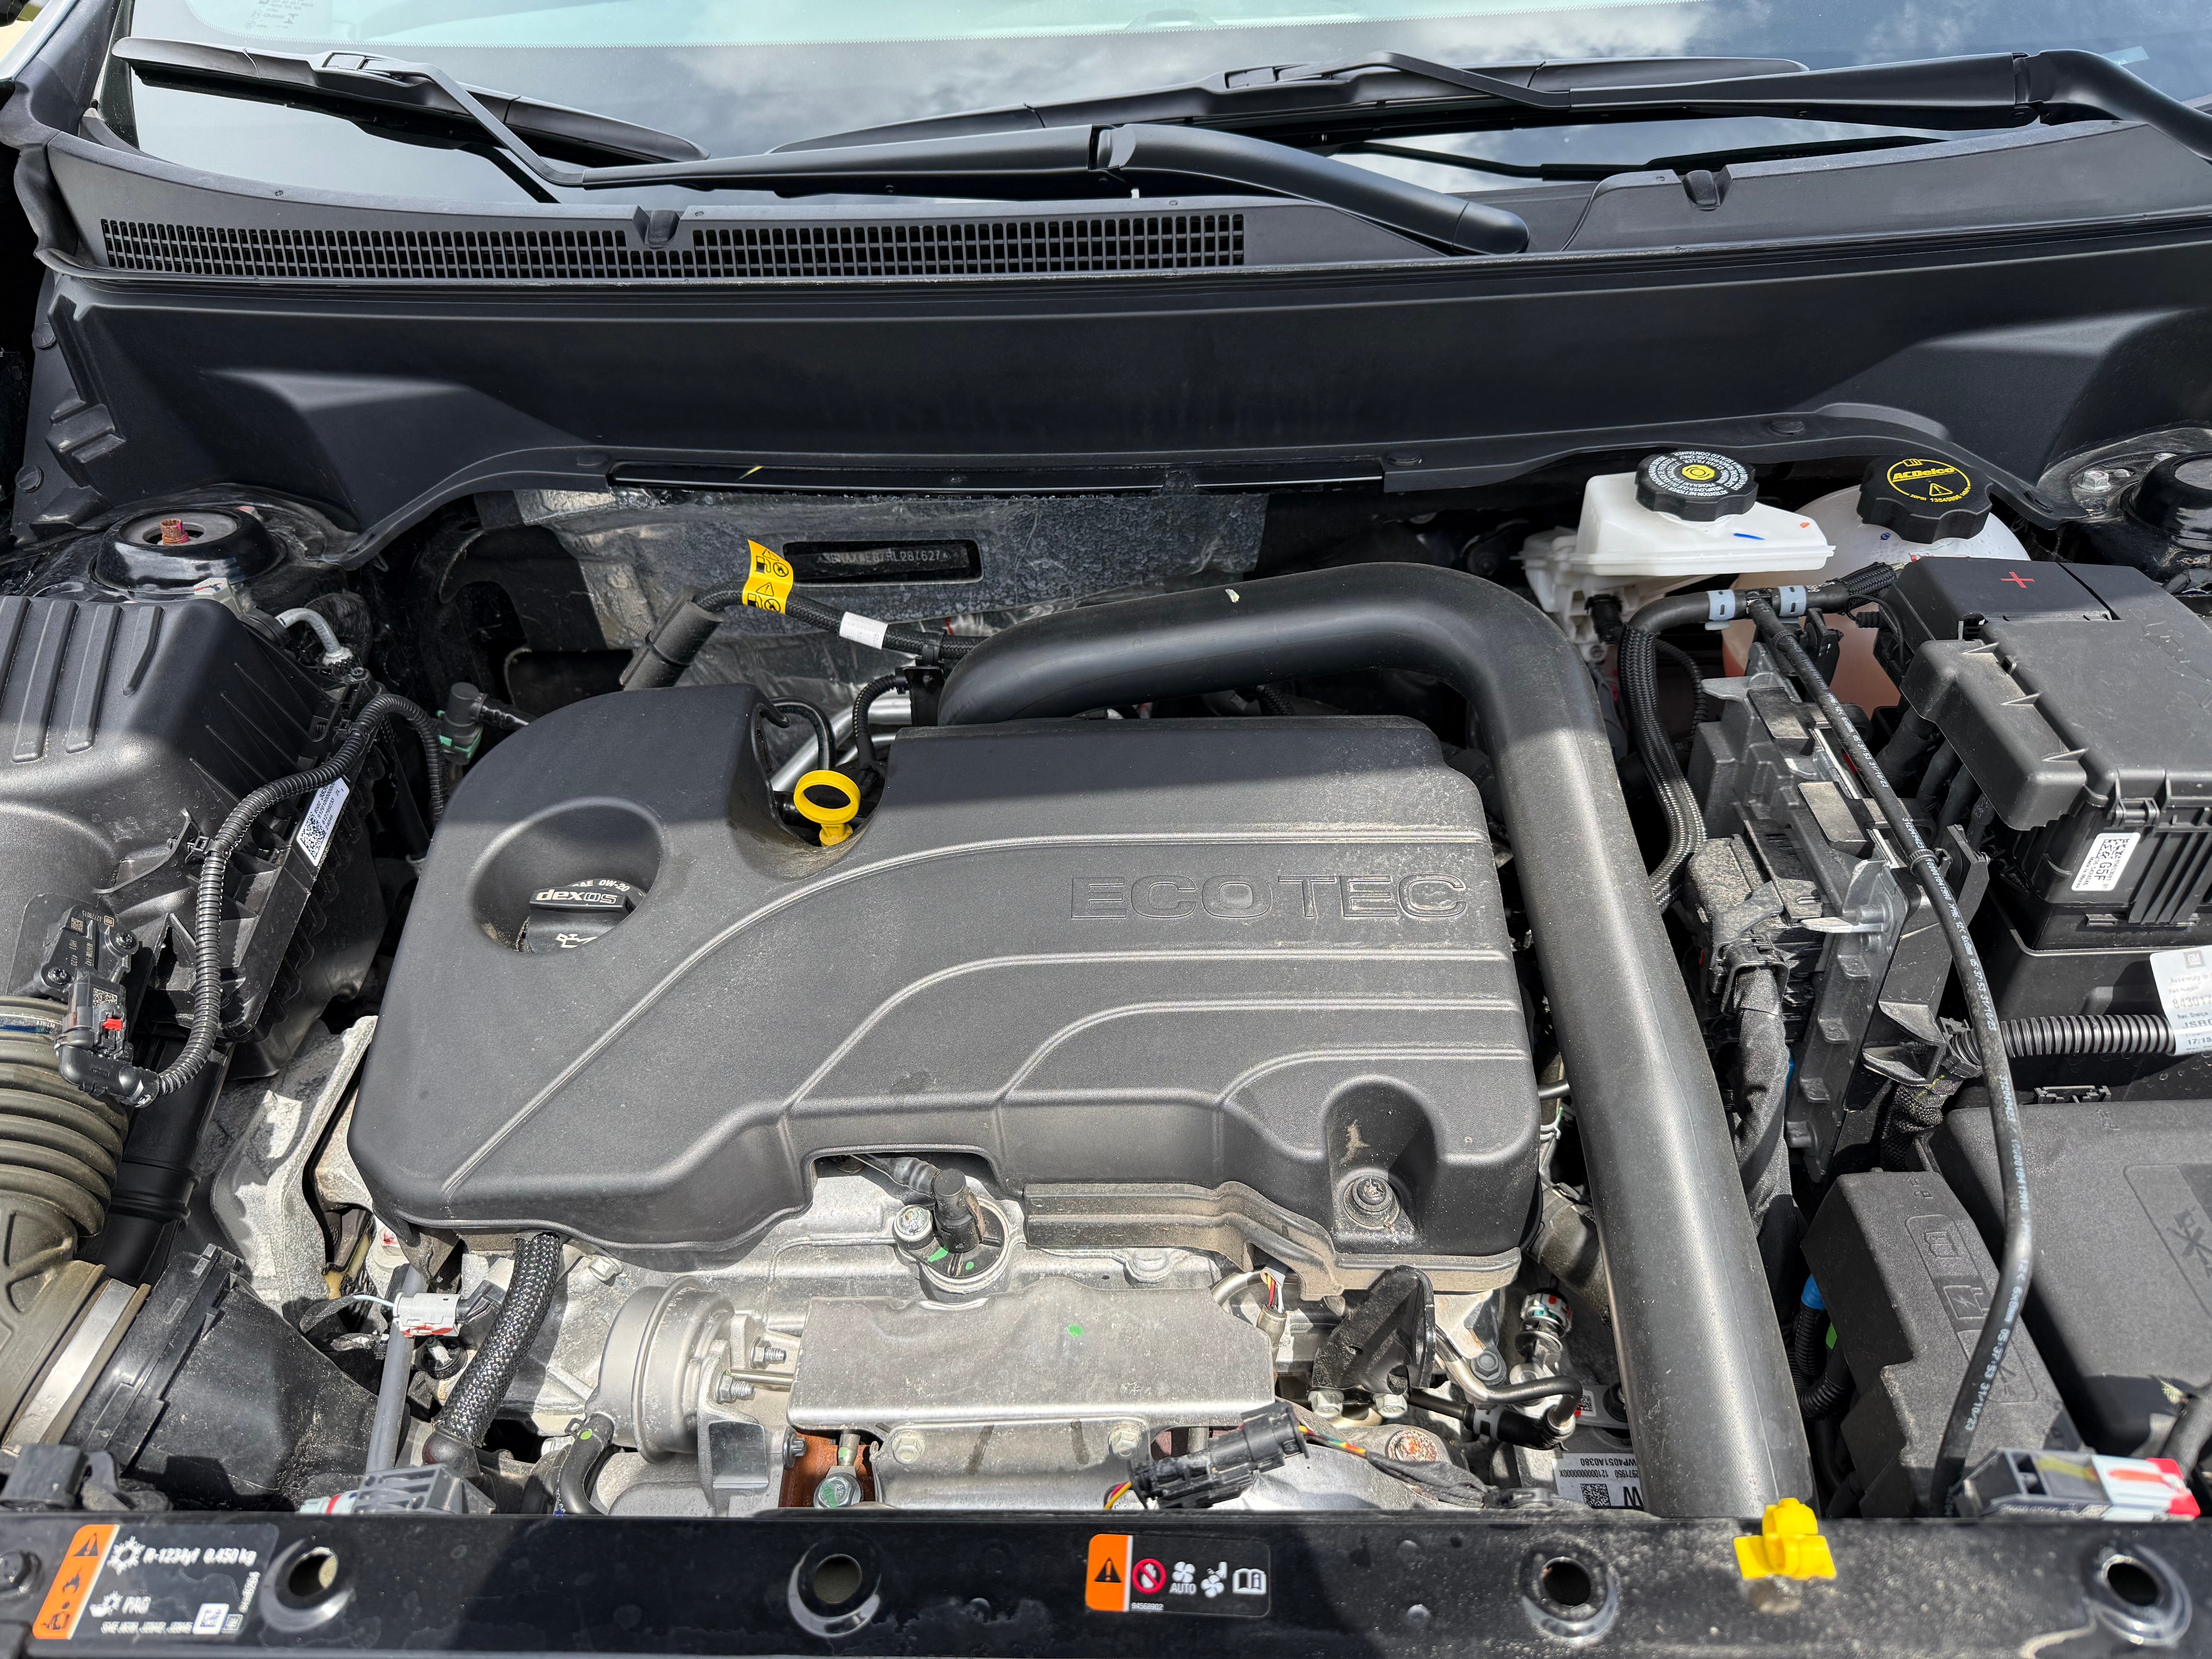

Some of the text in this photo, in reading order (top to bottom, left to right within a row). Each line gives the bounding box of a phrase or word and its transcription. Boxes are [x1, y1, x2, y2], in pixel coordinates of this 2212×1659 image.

[1893, 468, 1955, 480] ACDelco
[1852, 735, 1872, 760] 05:37:53
[1869, 761, 1889, 788] 31/10/23
[2094, 862, 2112, 881] G5F
[598, 879, 631, 892] 0W-20
[536, 889, 620, 905] dexos
[1071, 873, 1467, 919] ECOTEC
[2188, 953, 2202, 962] GM
[1980, 993, 1997, 1031] 31/10/23
[1984, 1328, 2011, 1379] 05:37:53
[1965, 1382, 1991, 1431] 31/10/23
[203, 1548, 239, 1565] 0.450
[238, 1547, 257, 1567] kg
[1168, 1582, 1197, 1595] AUTO
